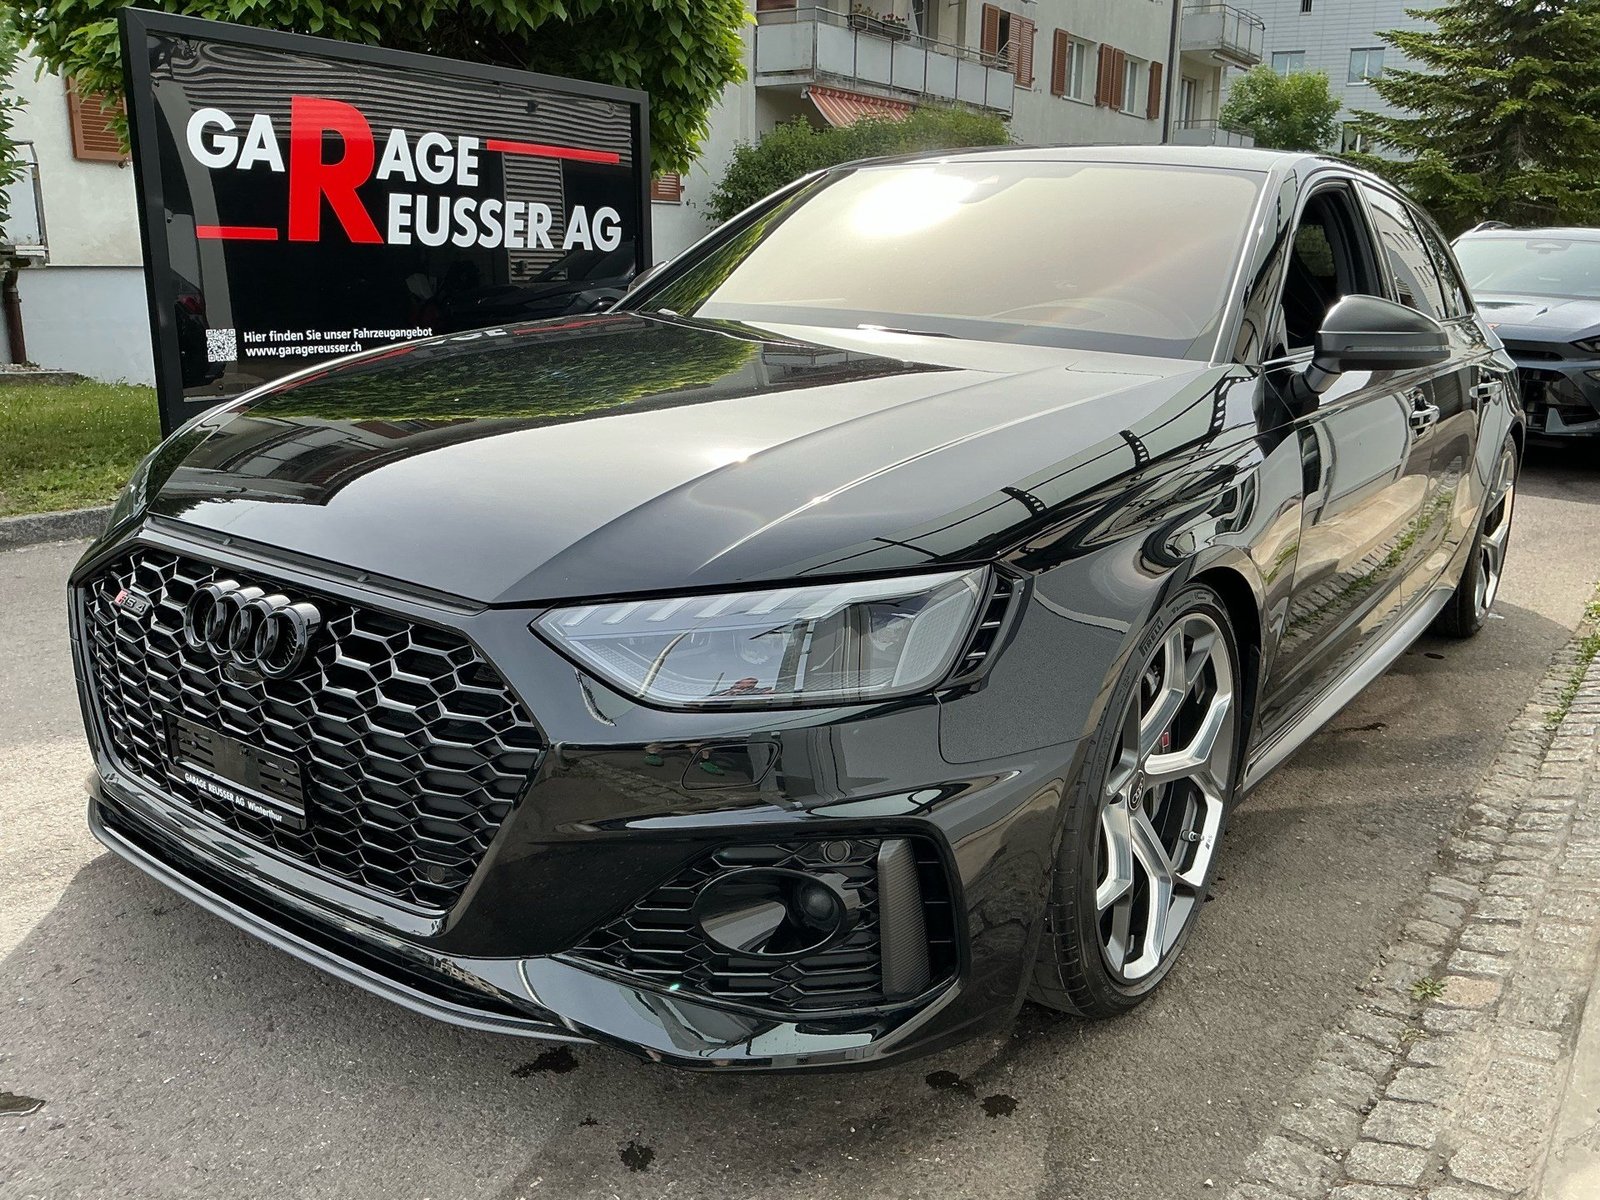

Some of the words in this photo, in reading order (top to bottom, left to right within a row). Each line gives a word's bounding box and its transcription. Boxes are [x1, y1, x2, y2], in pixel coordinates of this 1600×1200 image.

[186, 96, 480, 244] GARAGE
[562, 206, 622, 252] AG
[243, 331, 266, 343] Hier
[268, 329, 304, 342] finden
[306, 329, 322, 341] Sie
[323, 330, 352, 340] unser
[353, 326, 433, 340] Fahrzeugangebot
[245, 341, 362, 358] www.garagereusser.ch
[1138, 616, 1164, 657] PIRELLI
[184, 773, 207, 790] GARAGE
[208, 783, 235, 802] REUSSER
[235, 796, 246, 807] AG
[247, 801, 283, 822] Winterthur
